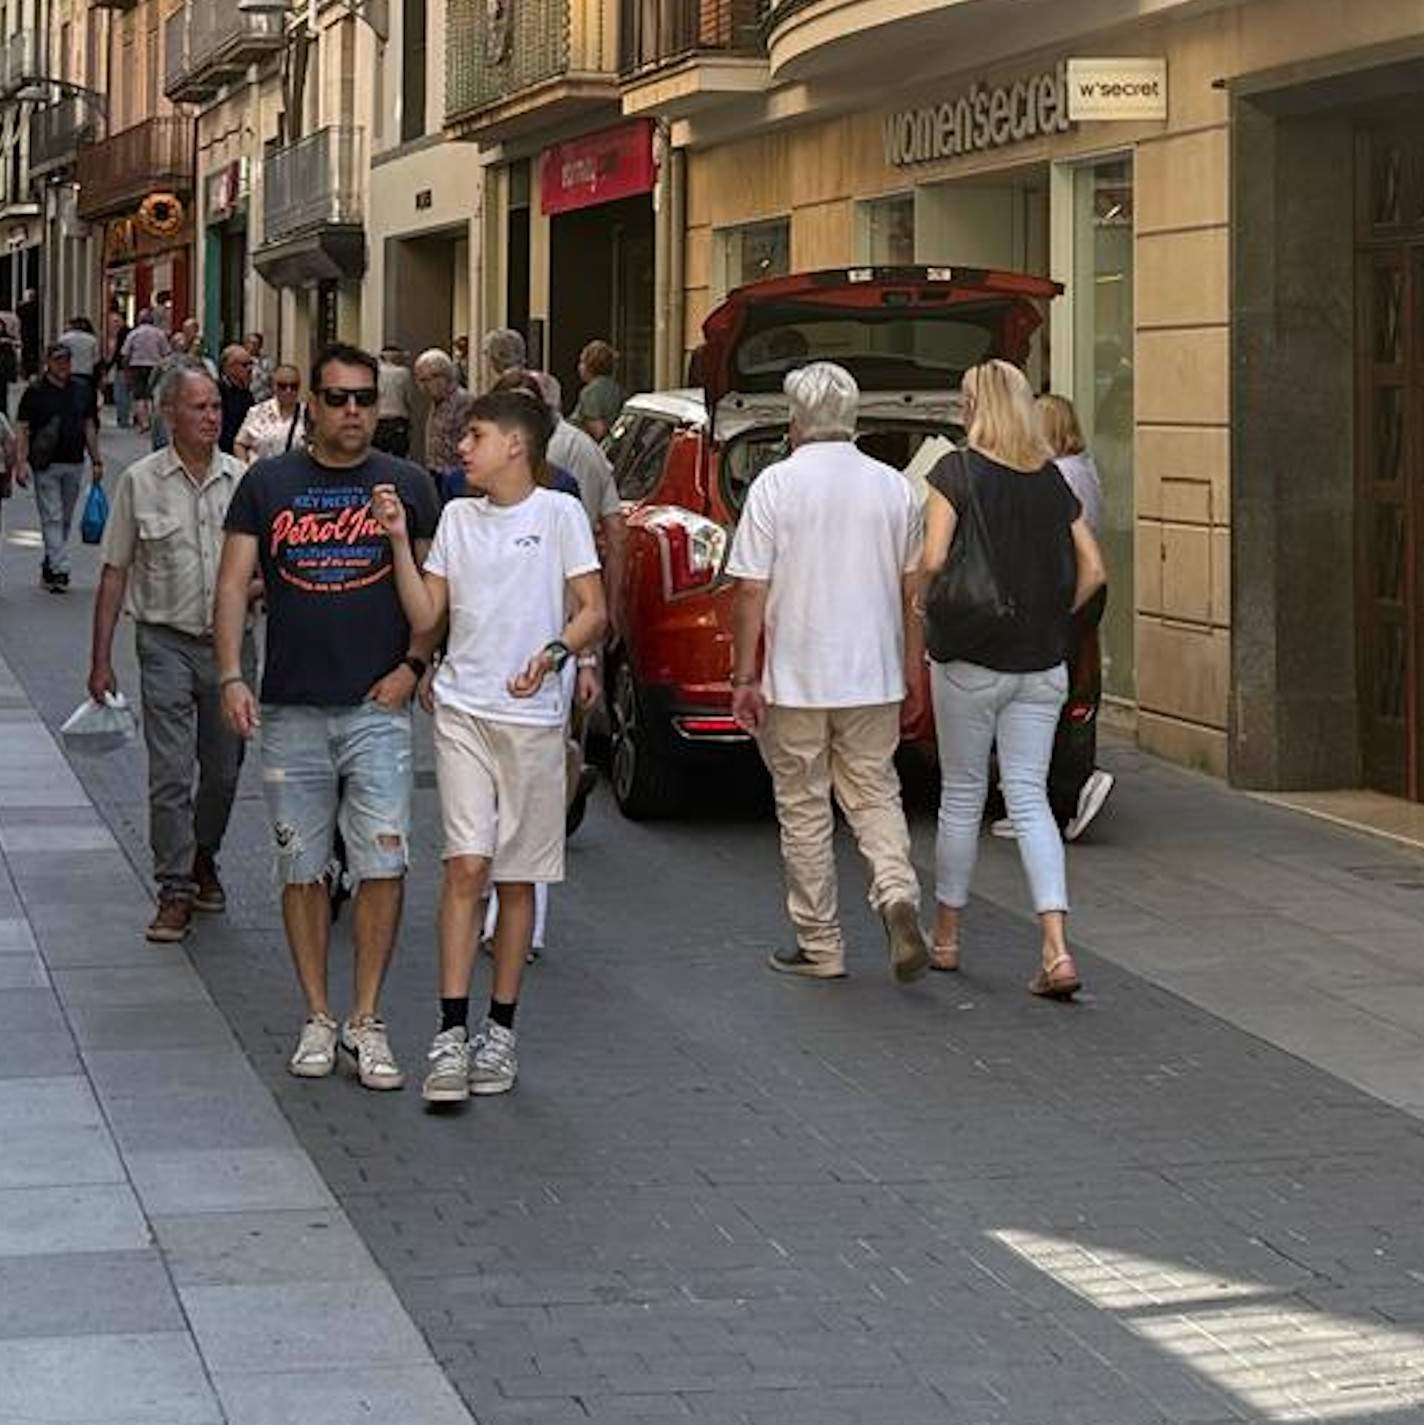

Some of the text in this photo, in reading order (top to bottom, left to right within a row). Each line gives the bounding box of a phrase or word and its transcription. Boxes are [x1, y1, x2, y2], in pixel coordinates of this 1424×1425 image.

[884, 60, 1069, 166] women'secret
[1079, 81, 1159, 97] w'secret
[270, 508, 351, 556] Petrol
